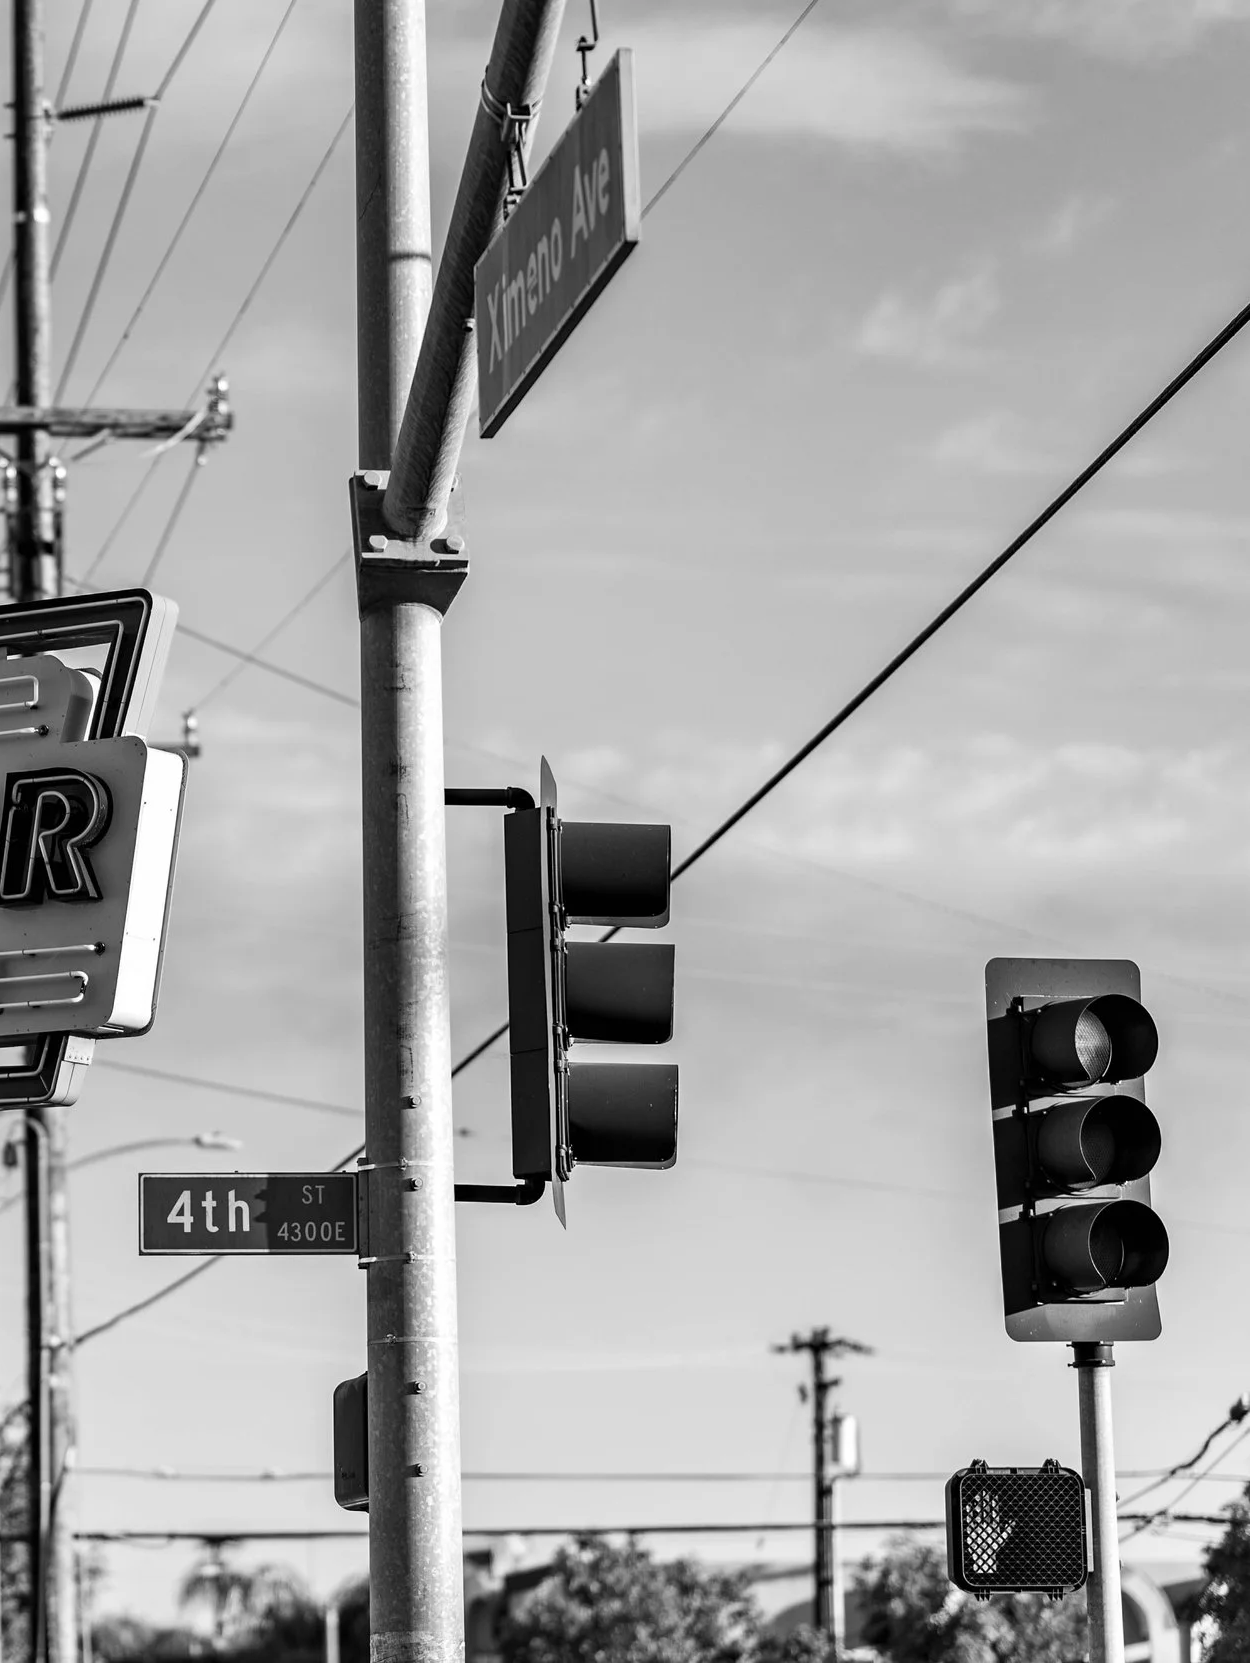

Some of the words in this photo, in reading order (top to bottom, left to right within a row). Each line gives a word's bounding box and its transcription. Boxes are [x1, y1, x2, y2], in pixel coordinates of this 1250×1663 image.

[486, 217, 563, 374] Ximeno
[570, 147, 611, 260] Ave
[166, 1188, 251, 1233] 4th
[301, 1184, 326, 1205] ST
[277, 1220, 346, 1242] 4300E
